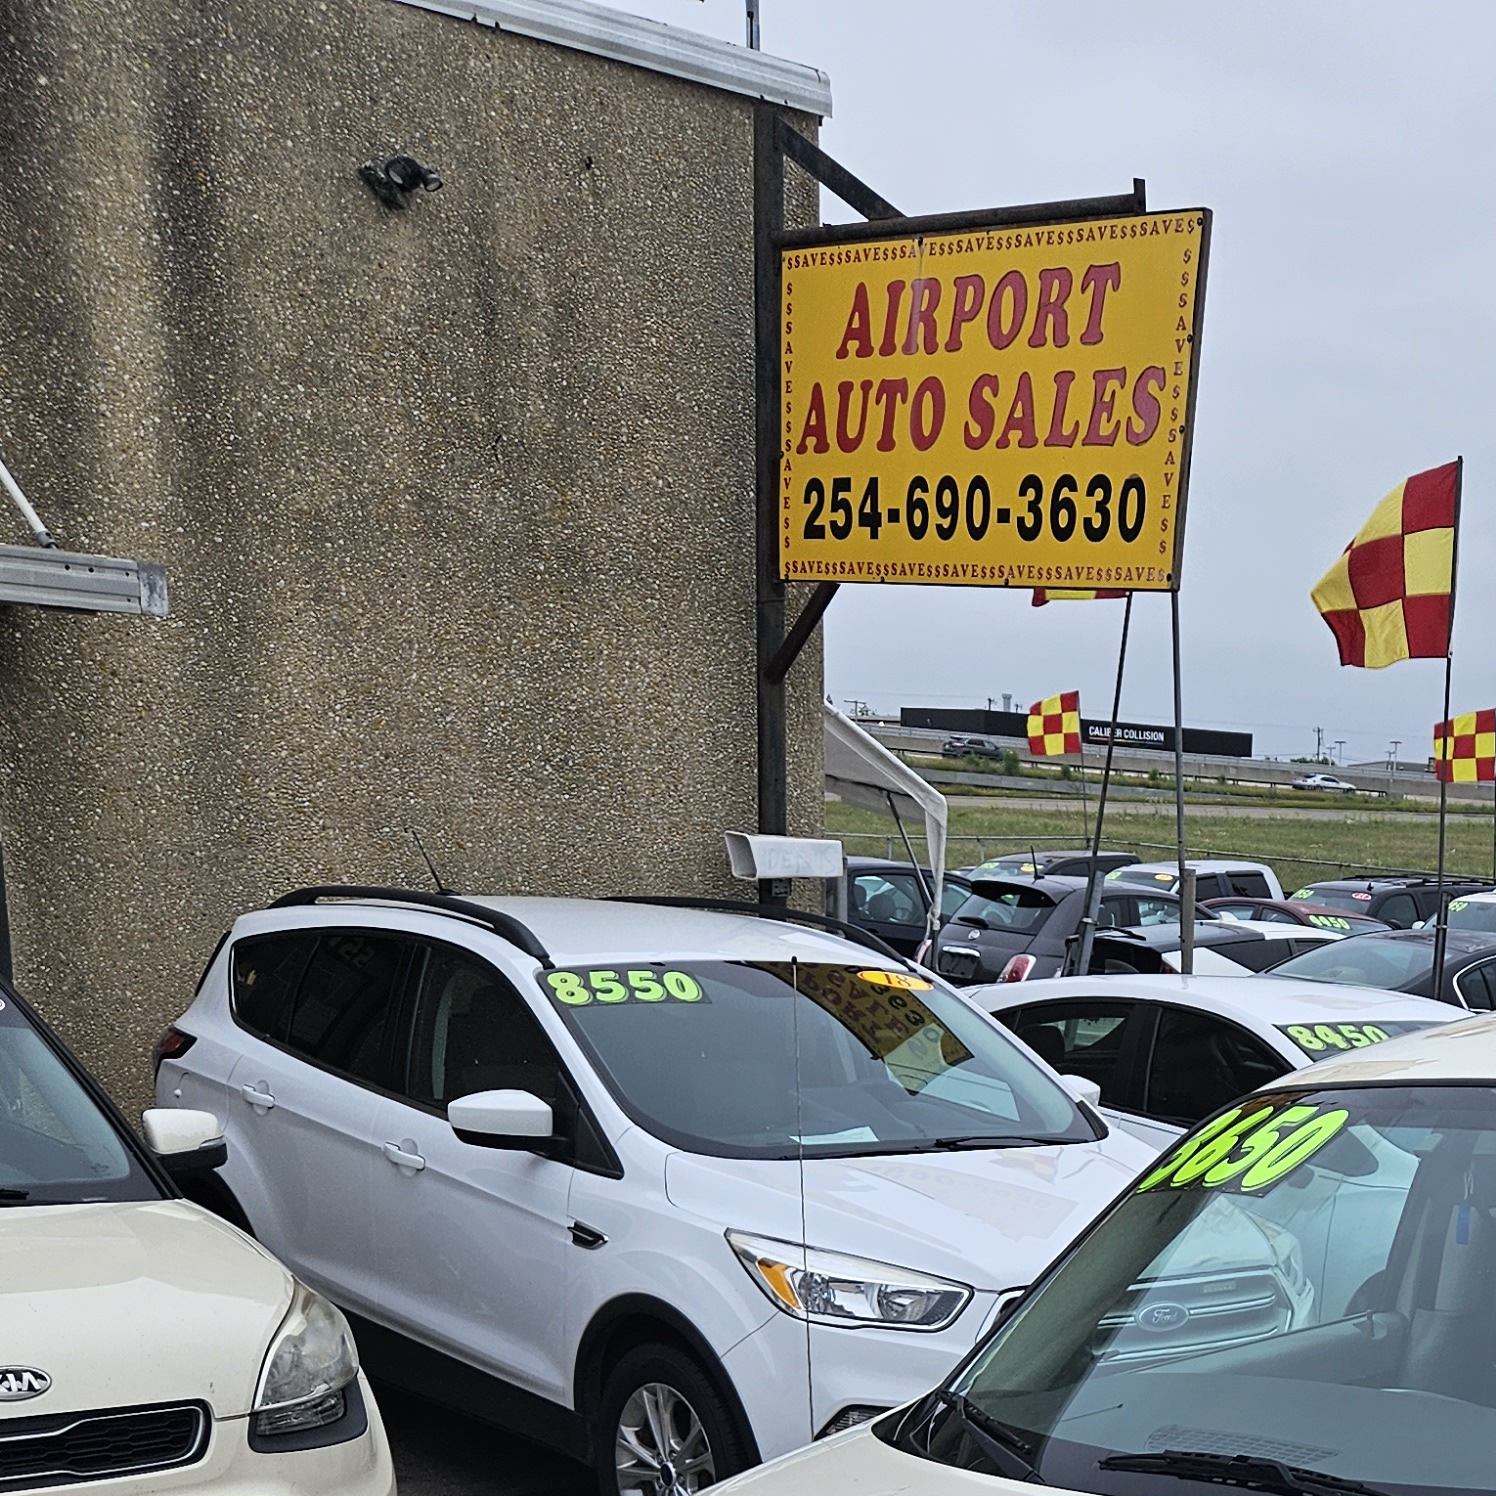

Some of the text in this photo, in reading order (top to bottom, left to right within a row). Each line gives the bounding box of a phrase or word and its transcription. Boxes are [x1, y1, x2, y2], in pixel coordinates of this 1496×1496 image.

[835, 261, 1121, 360] AIRPORT
[796, 365, 1166, 455] AUTO SALES
[803, 474, 1147, 542] 254-690-3630
[1088, 726, 1164, 741] CALIBR COLLISION
[547, 971, 703, 1006] 8550
[1287, 1025, 1391, 1051] 8450
[1153, 1308, 1178, 1323] Ford
